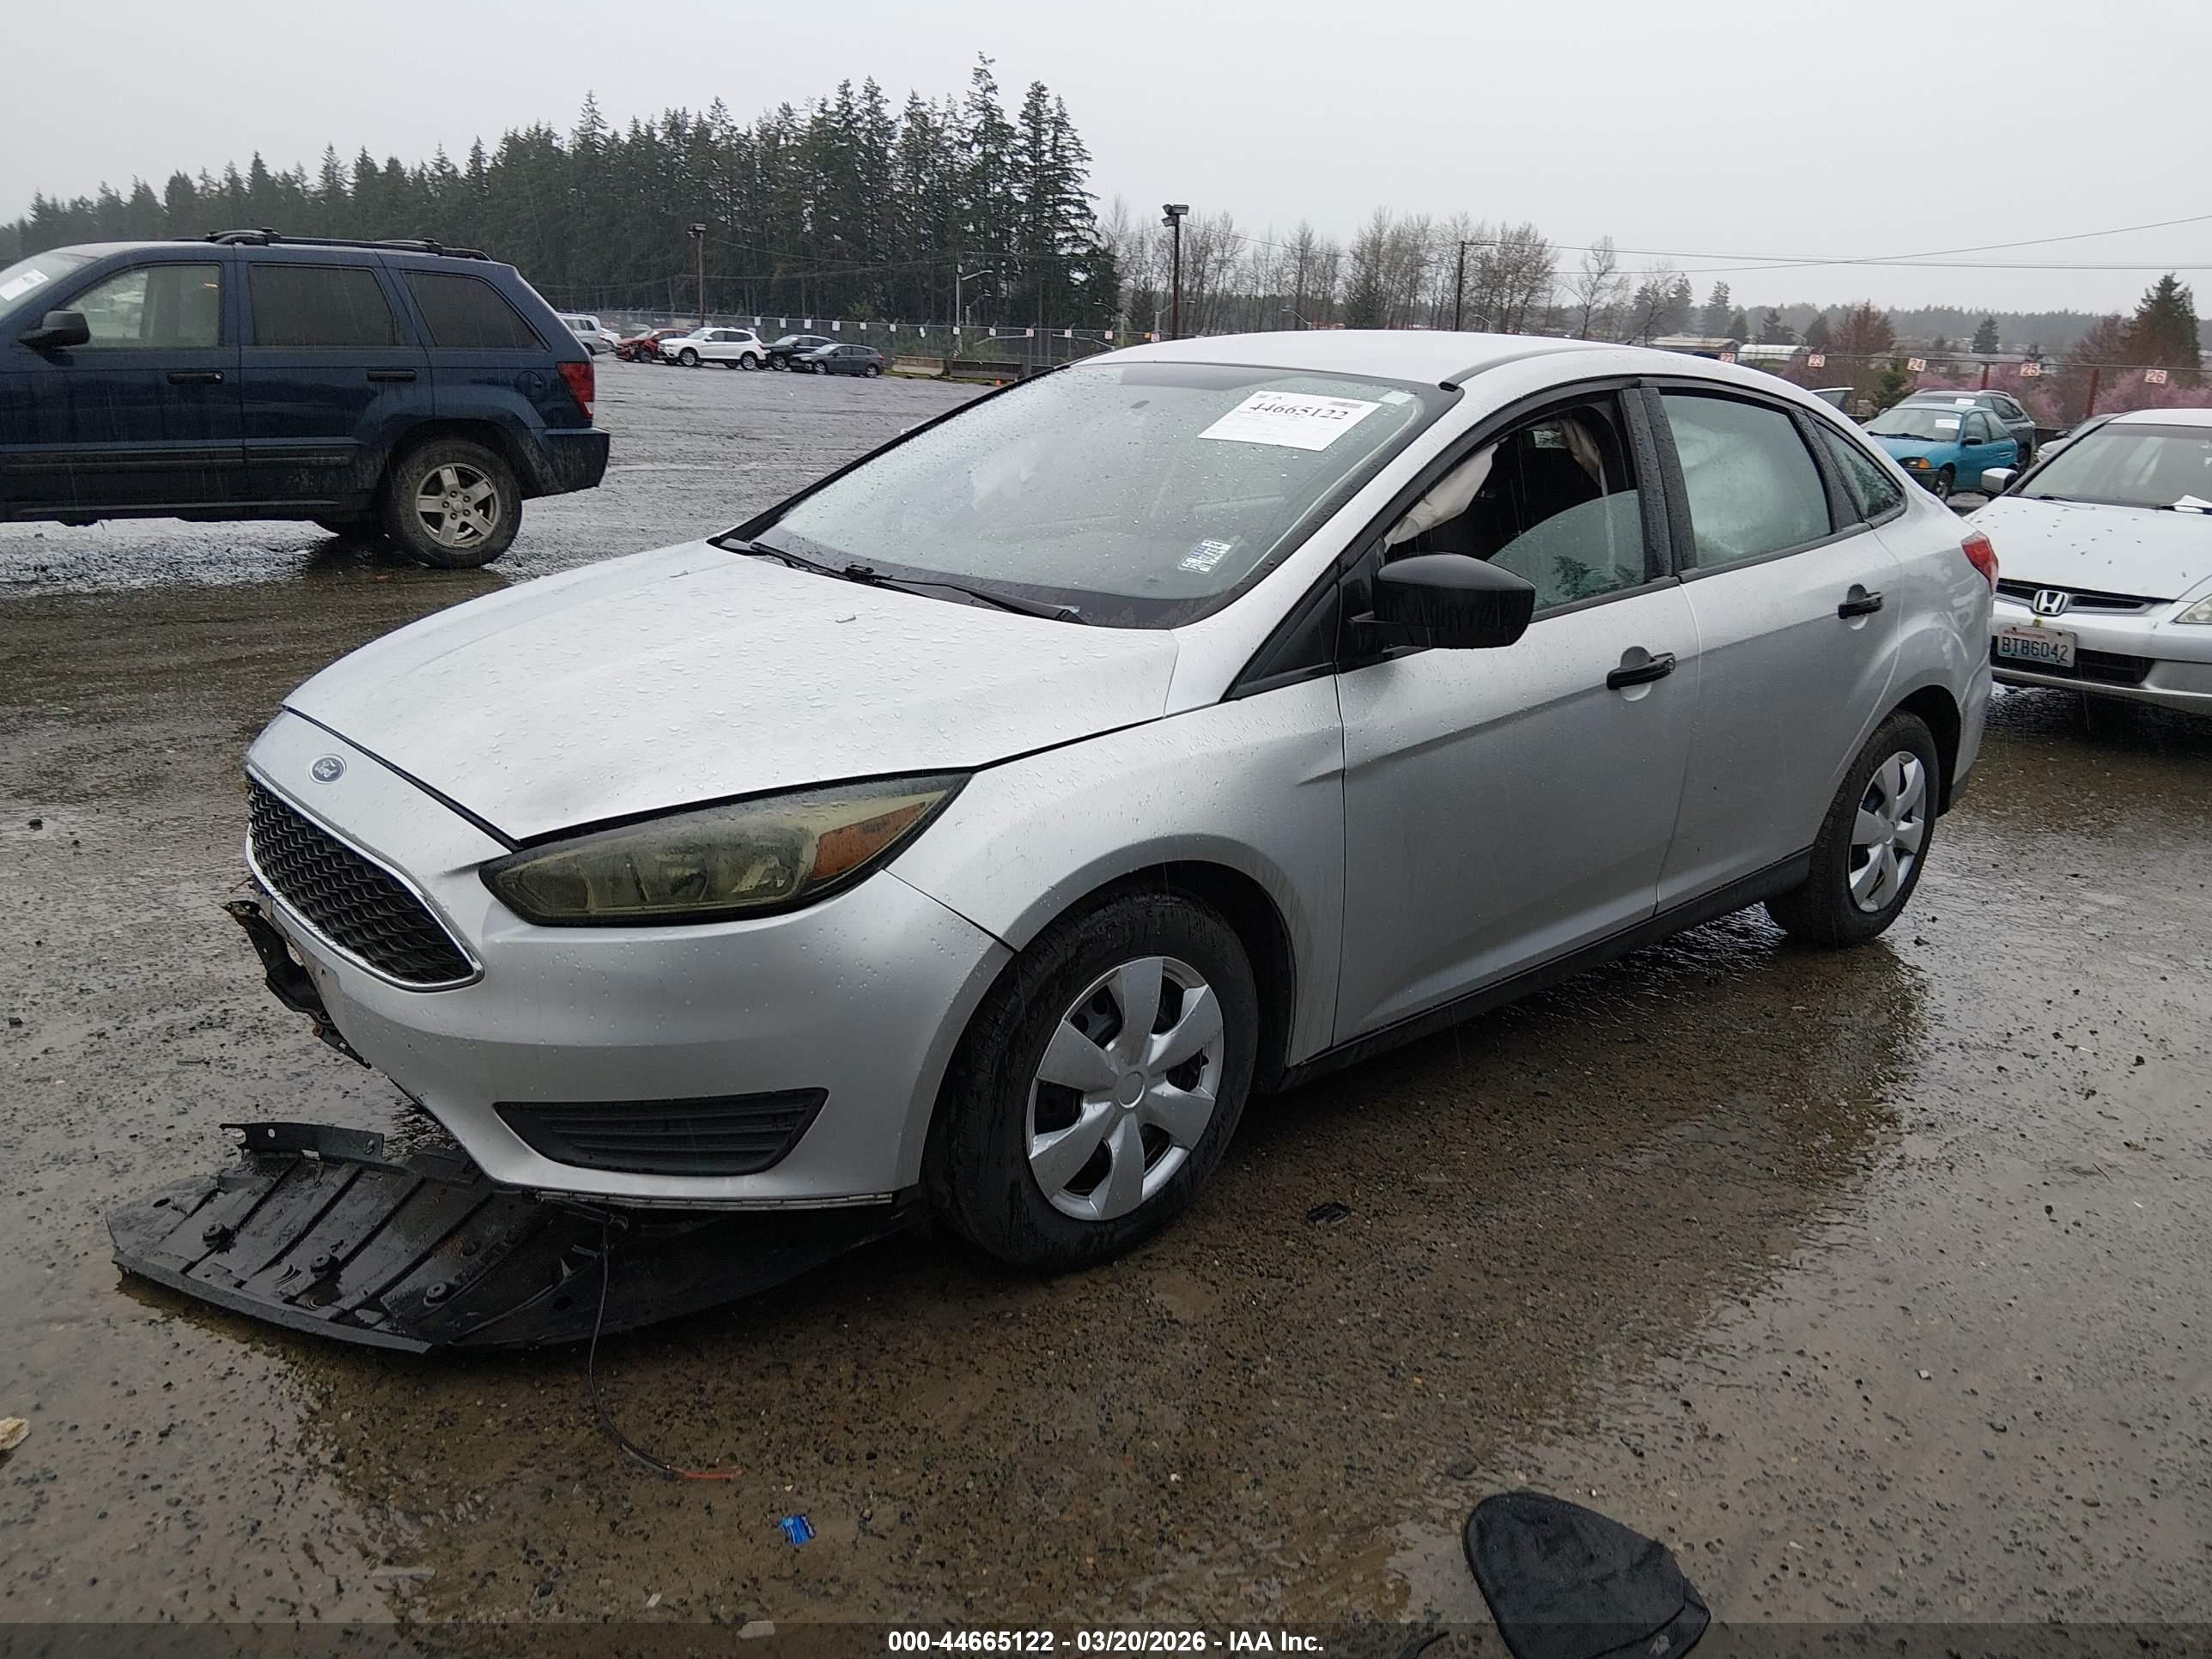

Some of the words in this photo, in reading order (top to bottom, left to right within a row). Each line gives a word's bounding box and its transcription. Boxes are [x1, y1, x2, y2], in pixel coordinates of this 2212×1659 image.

[1909, 359, 1924, 370] 24
[2022, 364, 2038, 375] 25
[2148, 370, 2165, 382] 26
[1249, 402, 1349, 420] 44665122
